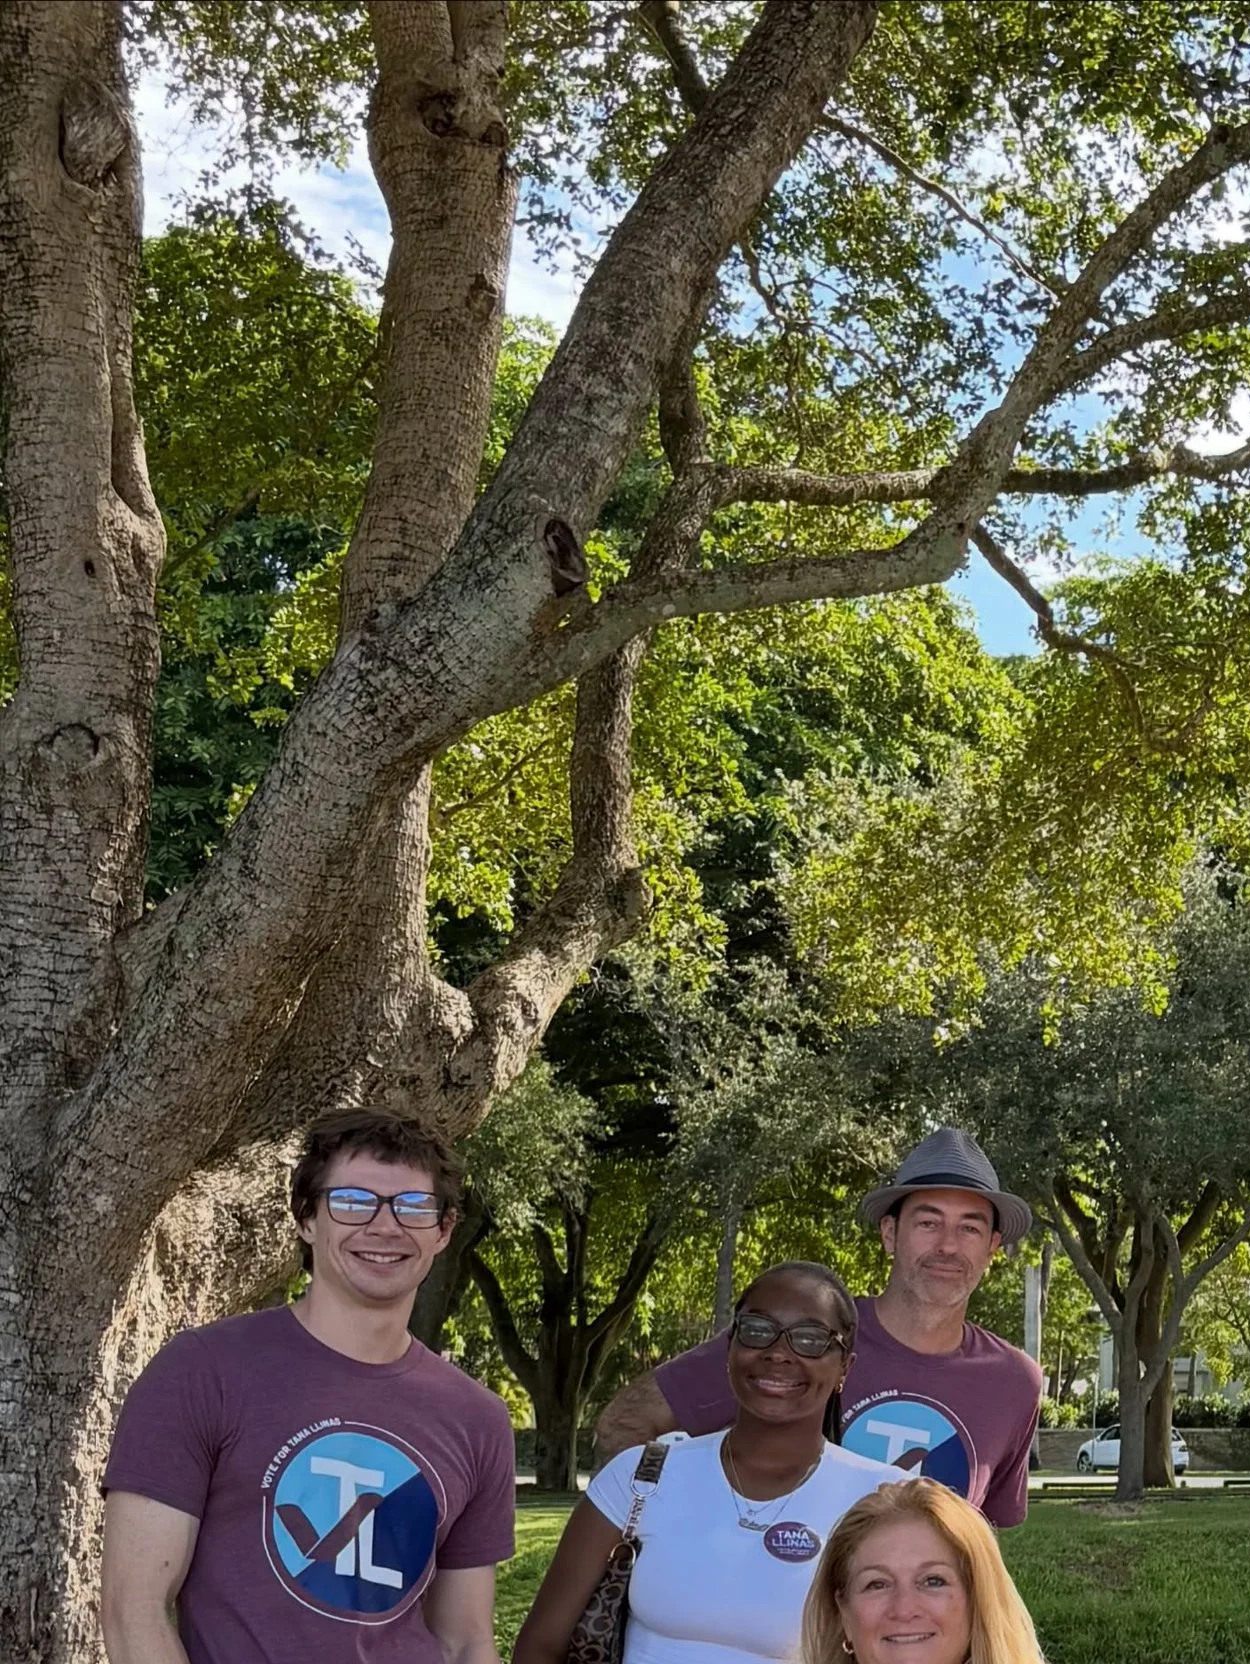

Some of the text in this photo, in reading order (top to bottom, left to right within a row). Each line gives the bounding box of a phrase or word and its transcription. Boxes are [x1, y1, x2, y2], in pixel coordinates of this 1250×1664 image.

[261, 1417, 341, 1488] VOTE FOR TANA LLINAS
[776, 1530, 809, 1540] TANA
[772, 1538, 815, 1548] LLINAS
